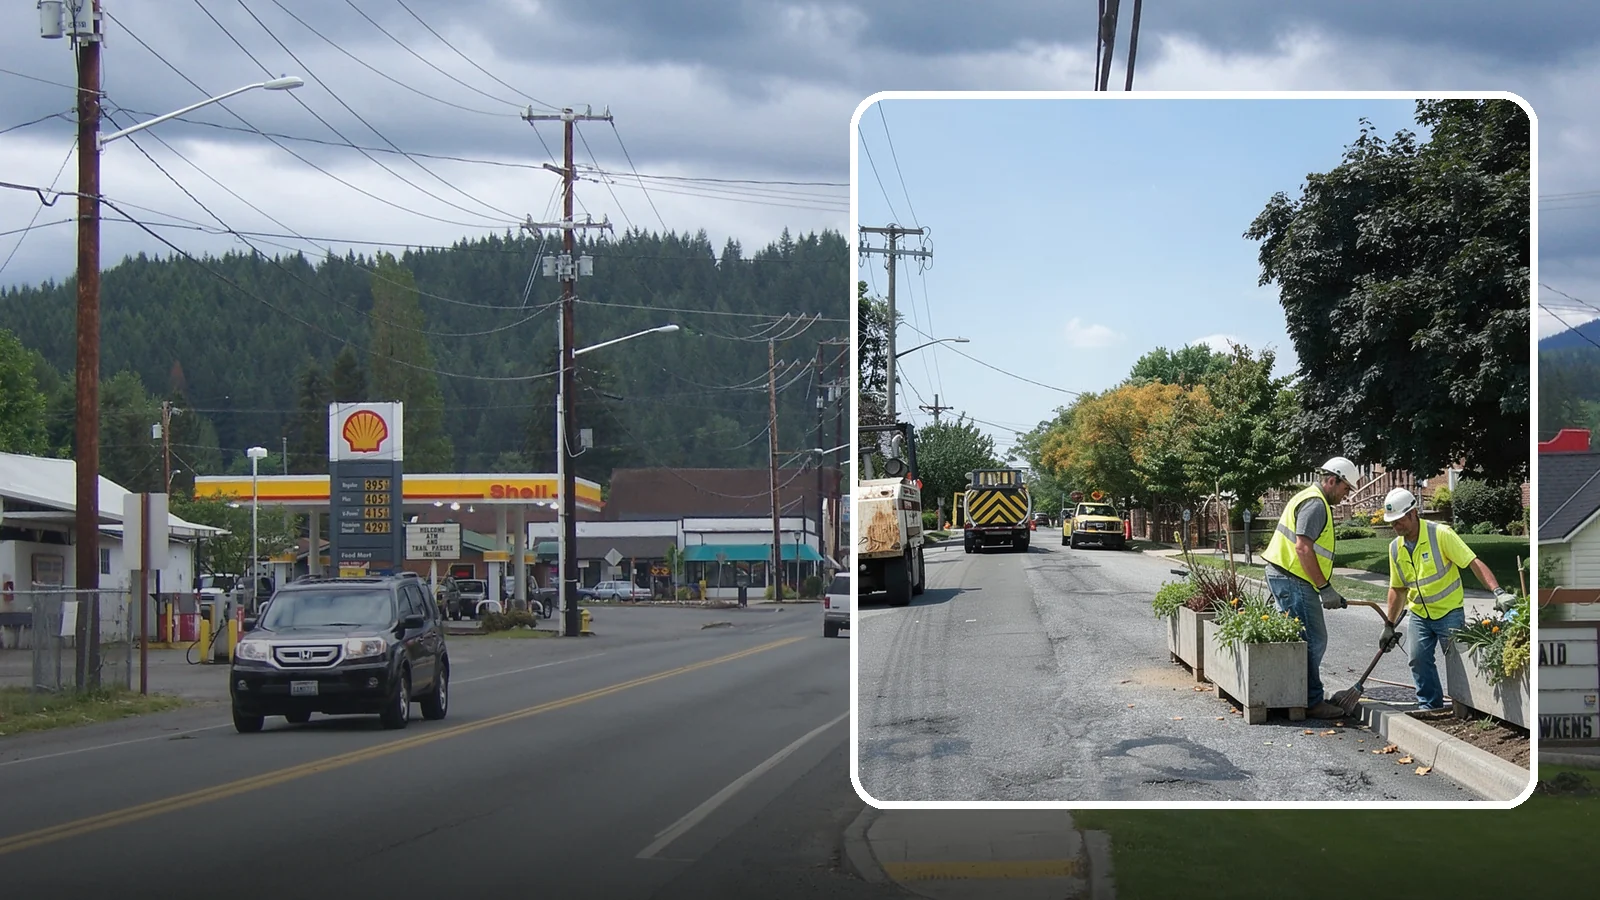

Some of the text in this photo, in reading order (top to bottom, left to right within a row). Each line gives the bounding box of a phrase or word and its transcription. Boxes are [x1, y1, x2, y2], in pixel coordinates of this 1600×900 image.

[365, 480, 383, 490] 395
[490, 484, 547, 499] Shell
[365, 494, 383, 504] 405
[365, 508, 383, 518] 415
[365, 522, 383, 533] 429
